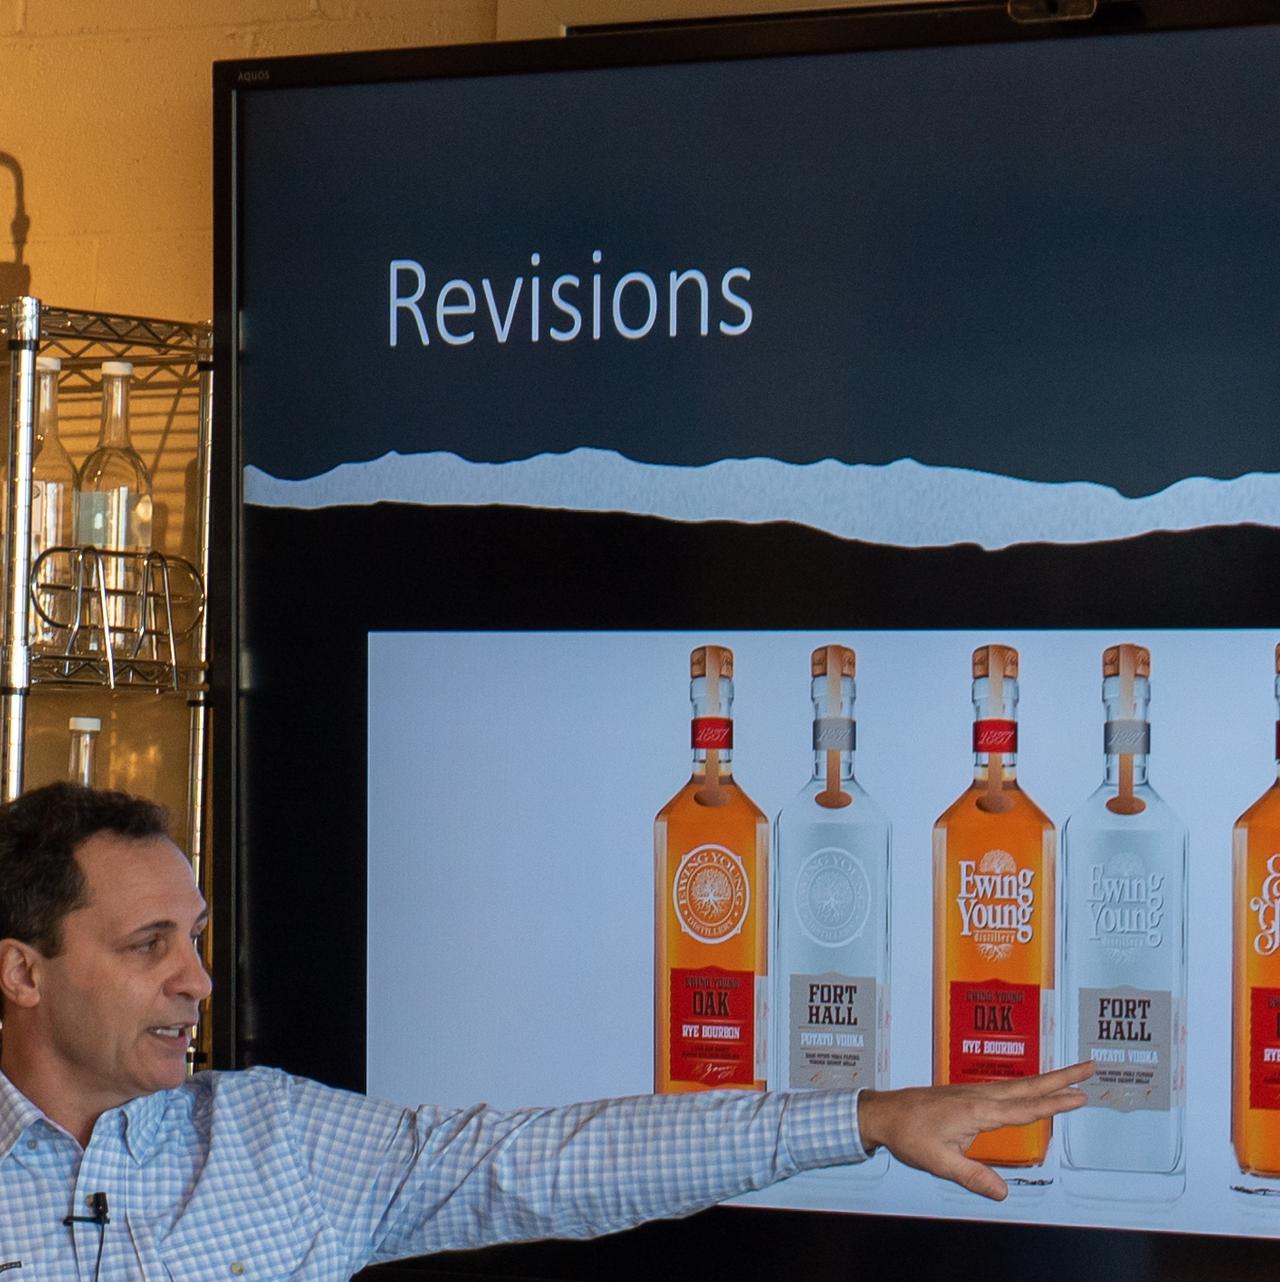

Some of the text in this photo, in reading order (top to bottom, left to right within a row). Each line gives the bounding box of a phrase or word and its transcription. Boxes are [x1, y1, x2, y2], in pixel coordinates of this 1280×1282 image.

[239, 71, 270, 81] AQUOS
[389, 250, 753, 347] Revisions
[958, 860, 1035, 908] Ewing
[957, 897, 1035, 944] Young
[974, 931, 1015, 944] distillery
[692, 990, 731, 1018] OAK
[808, 984, 858, 1005] FORT
[807, 1005, 858, 1026] HALL
[973, 1005, 1014, 1032] OAK
[1099, 998, 1152, 1019] FORT
[681, 1024, 740, 1040] RYE BOURBON
[799, 1032, 834, 1047] POTATO
[1097, 1020, 1152, 1042] HALL
[962, 1039, 1025, 1056] RYE BOURBON
